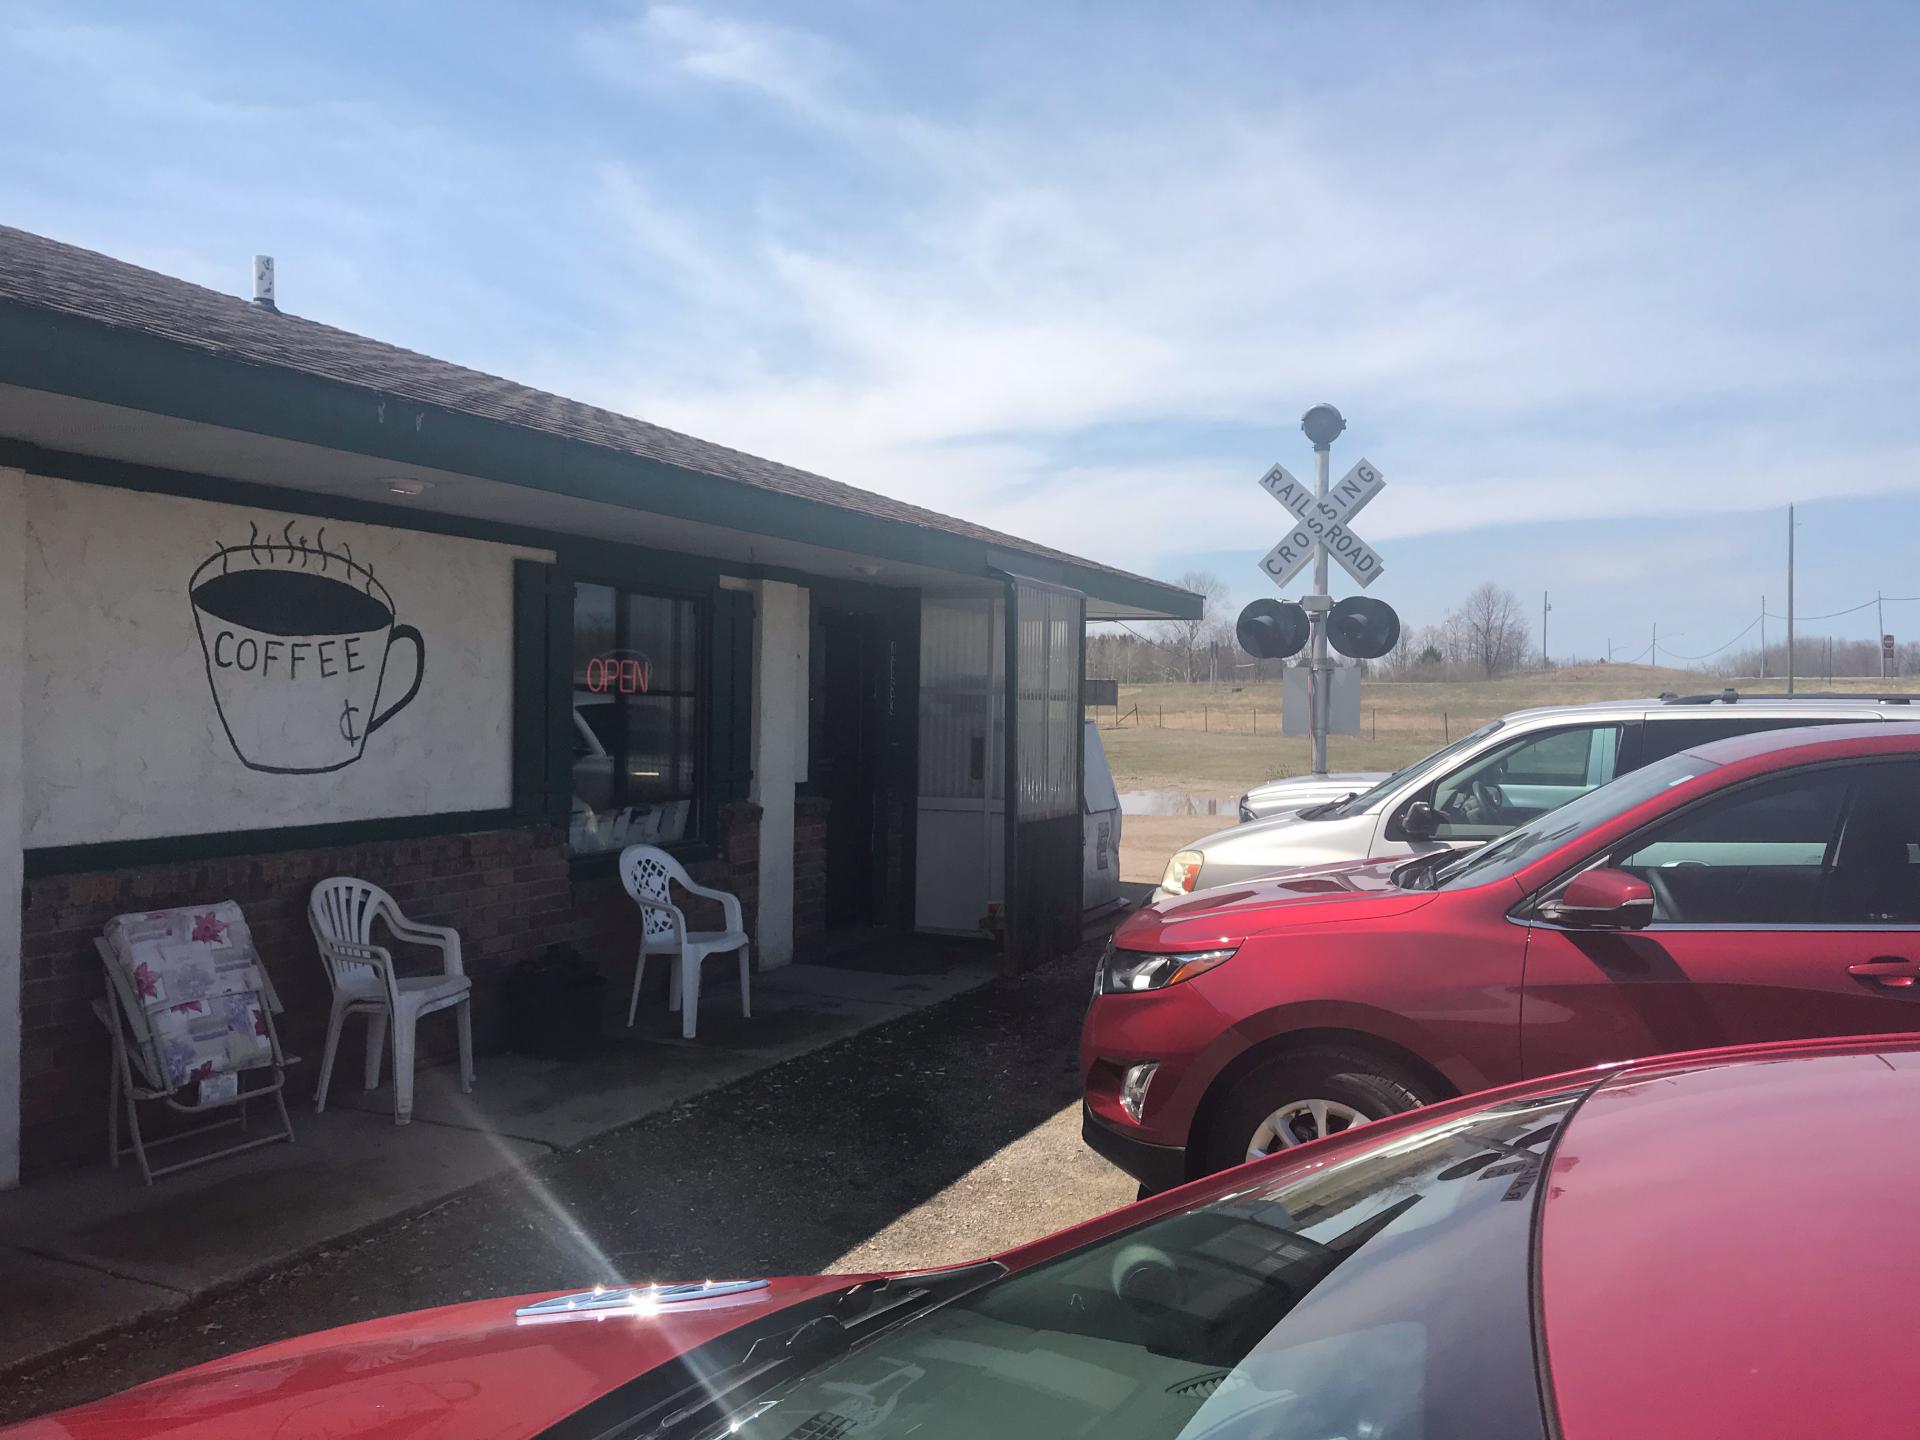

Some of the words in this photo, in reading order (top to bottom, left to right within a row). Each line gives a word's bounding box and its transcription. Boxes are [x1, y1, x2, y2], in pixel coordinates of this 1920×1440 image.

[1265, 466, 1375, 576] CROSSING
[214, 631, 365, 680] COFFEE
[586, 657, 649, 693] OPEN
